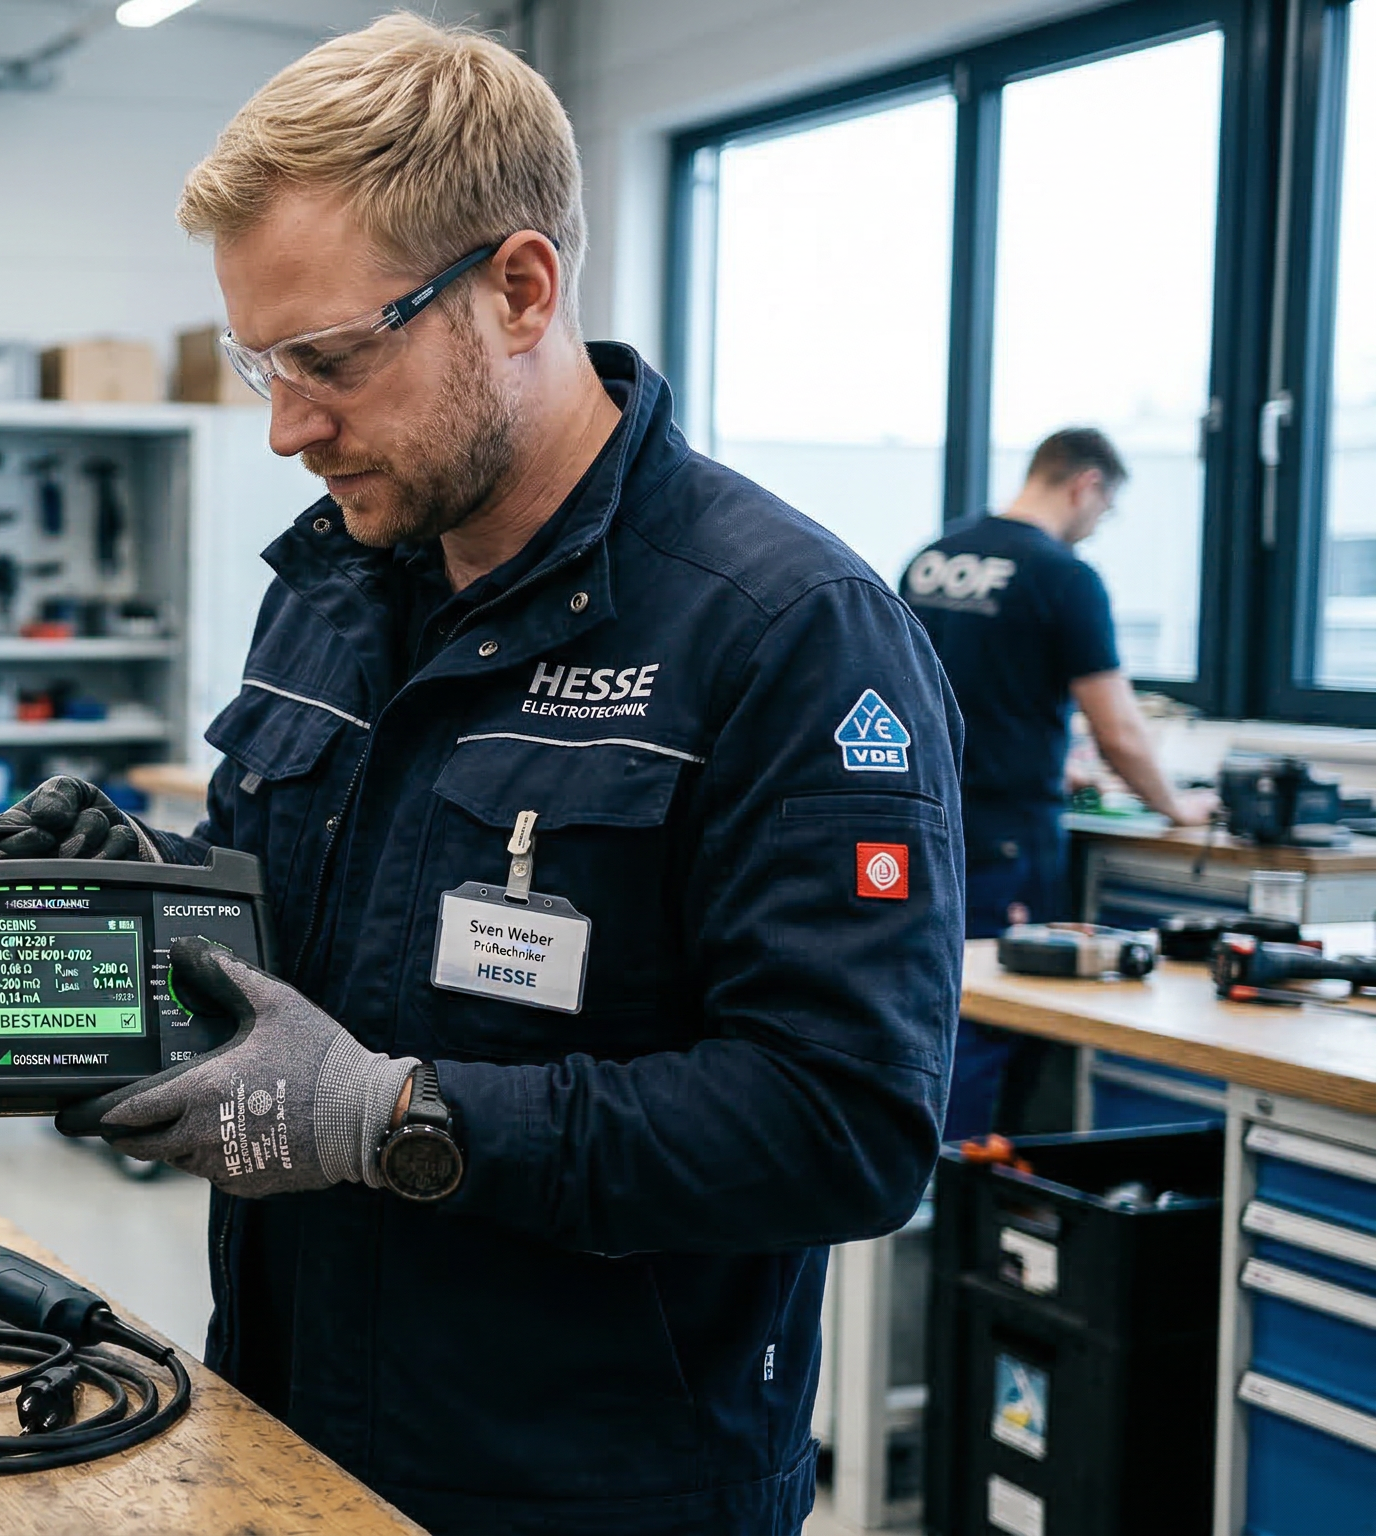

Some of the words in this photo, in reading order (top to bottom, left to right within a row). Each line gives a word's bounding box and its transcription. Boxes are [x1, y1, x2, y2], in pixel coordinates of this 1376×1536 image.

[528, 662, 660, 701] HESSE
[521, 700, 649, 719] ELEKTROTECHNIK
[852, 749, 901, 764] VDE
[163, 905, 216, 917] SECUTEST
[218, 905, 241, 917] PRO
[469, 919, 503, 938] Sven
[507, 926, 554, 947] Weber
[115, 977, 134, 989] mA
[477, 963, 537, 988] HESSE
[23, 992, 41, 1004] mA
[0, 1013, 96, 1029] BESTANDEN
[13, 1054, 51, 1065] GOSSEN
[53, 1053, 109, 1065] METRAWATT
[219, 1100, 243, 1177] HESSE
